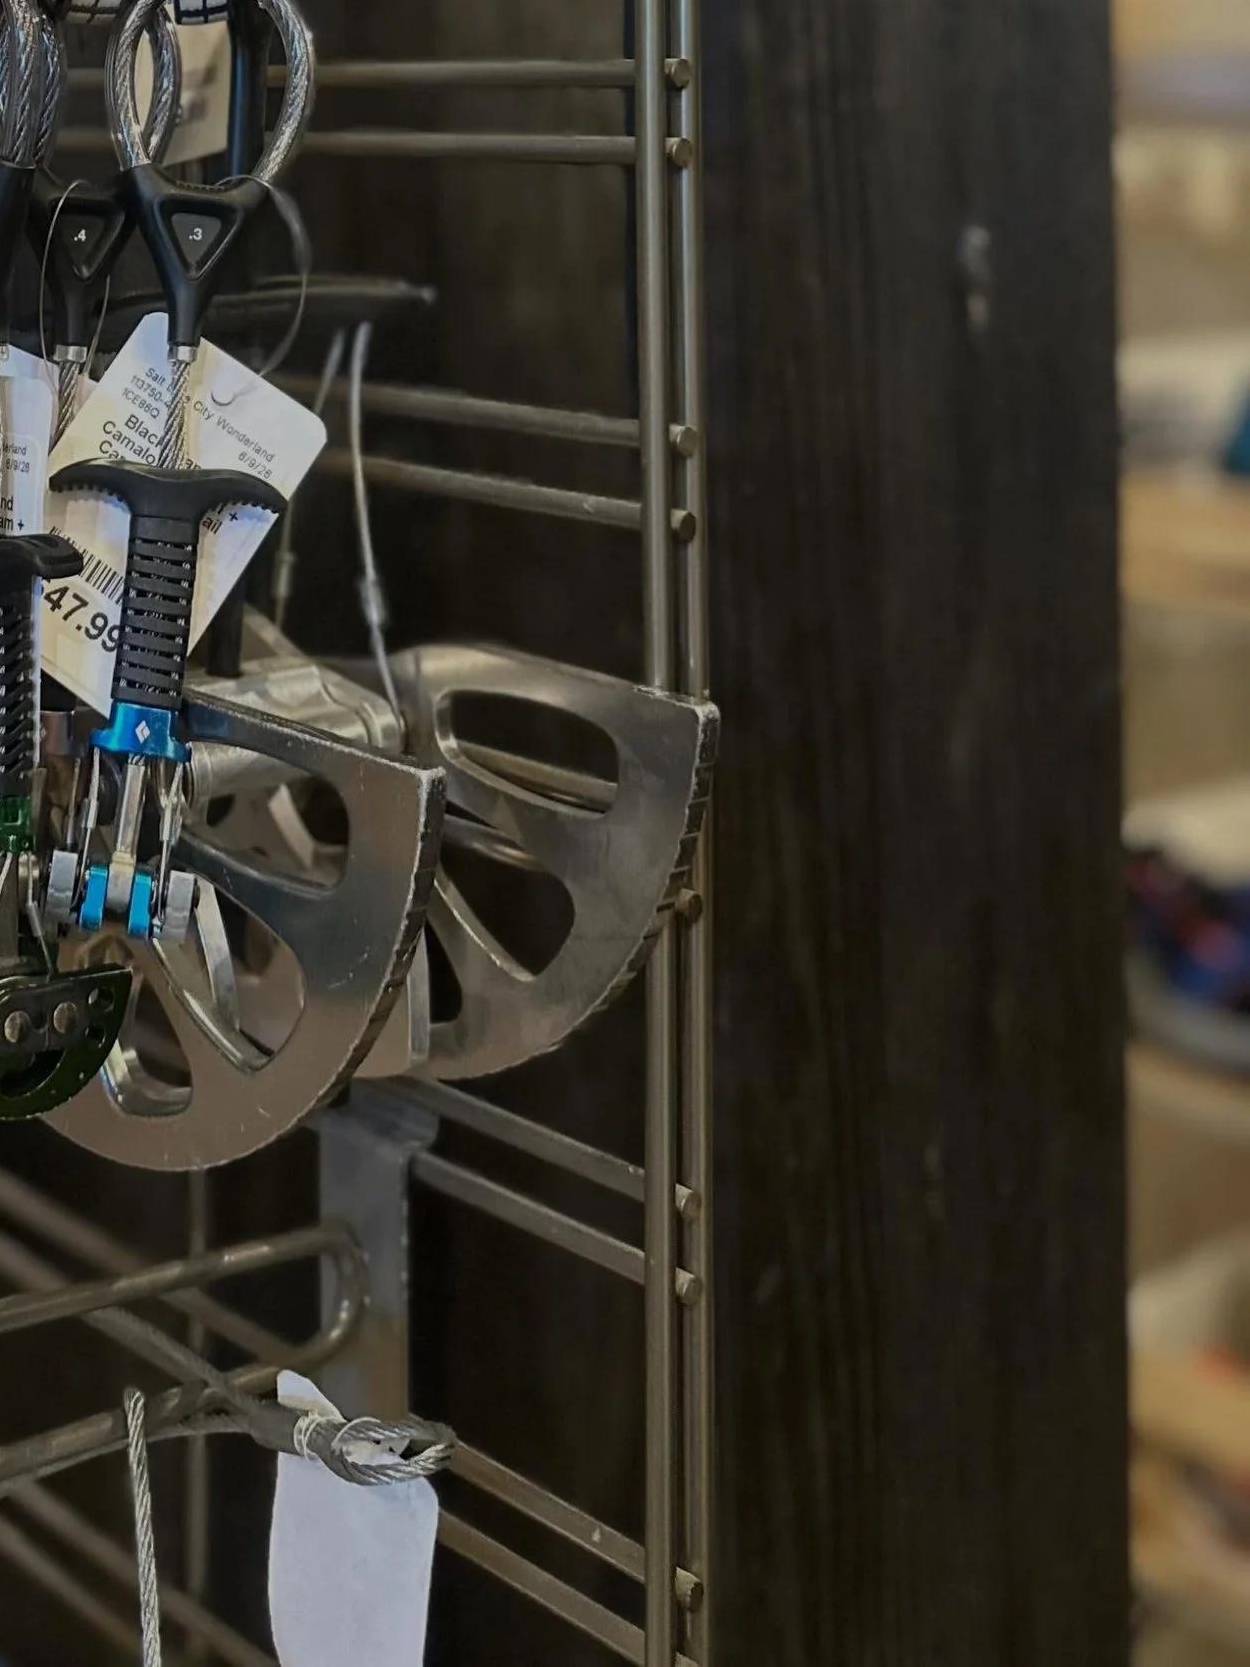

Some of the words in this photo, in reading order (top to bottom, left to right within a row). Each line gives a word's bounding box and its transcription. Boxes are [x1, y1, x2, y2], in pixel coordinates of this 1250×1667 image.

[188, 227, 203, 242] .3
[102, 420, 157, 466] Camalo
[145, 367, 166, 387] Salt
[193, 400, 215, 421] City
[216, 416, 276, 463] Wonderland
[42, 580, 121, 653] 47.99
